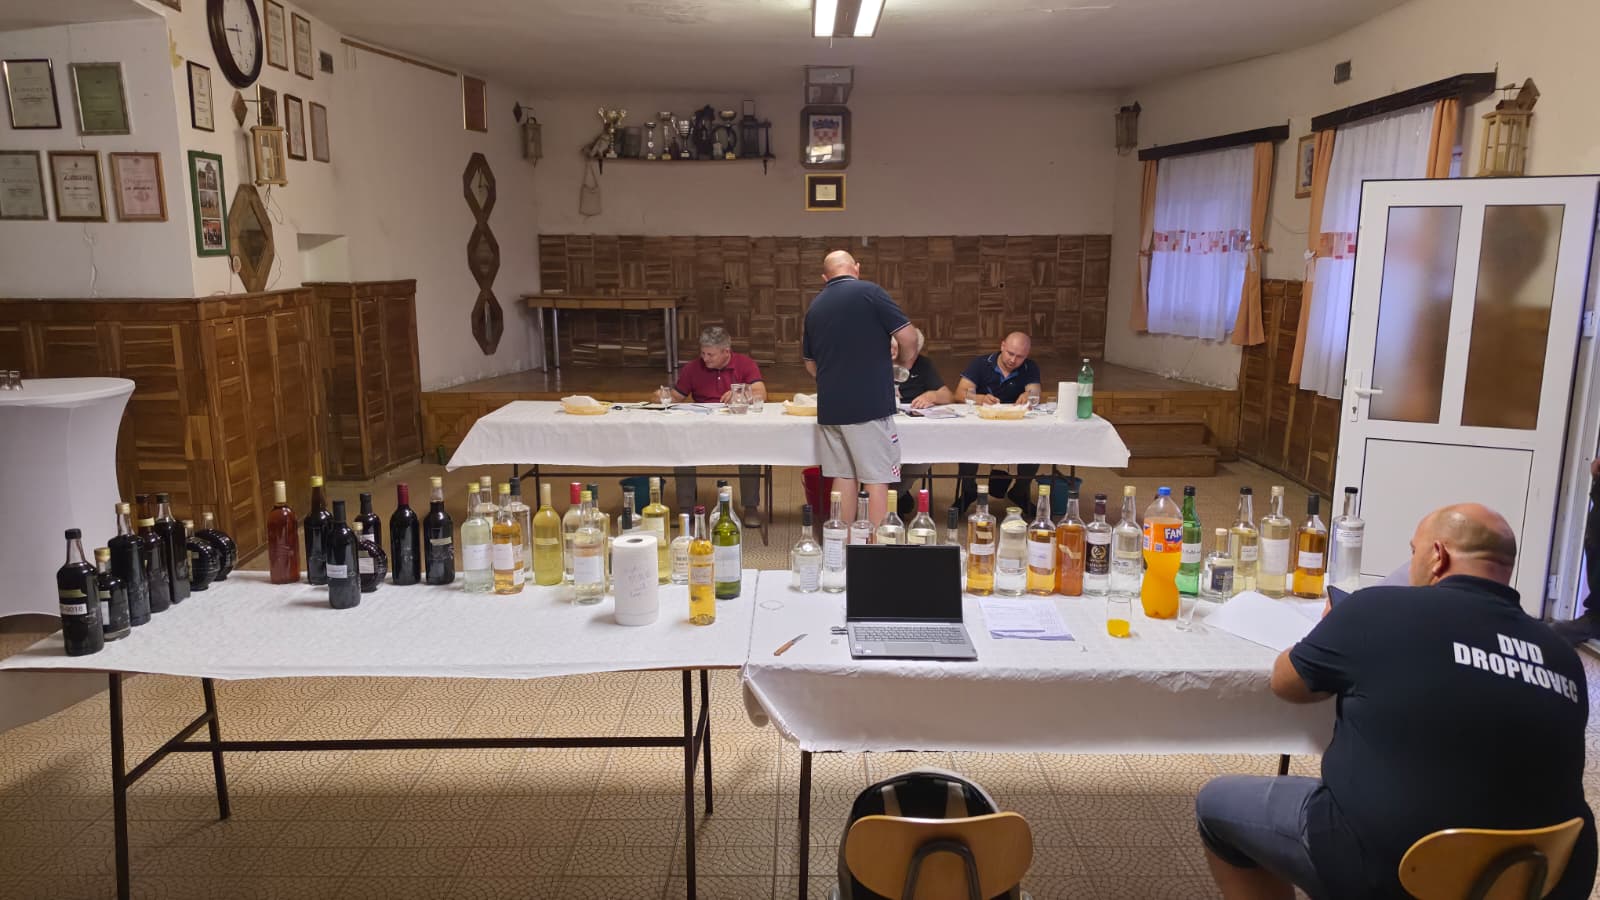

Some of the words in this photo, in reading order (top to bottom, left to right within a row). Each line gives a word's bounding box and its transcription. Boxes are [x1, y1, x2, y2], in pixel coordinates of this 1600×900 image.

[1164, 526, 1183, 540] FAN
[1497, 633, 1544, 664] DVD
[1453, 642, 1578, 703] DROPKOVEC
